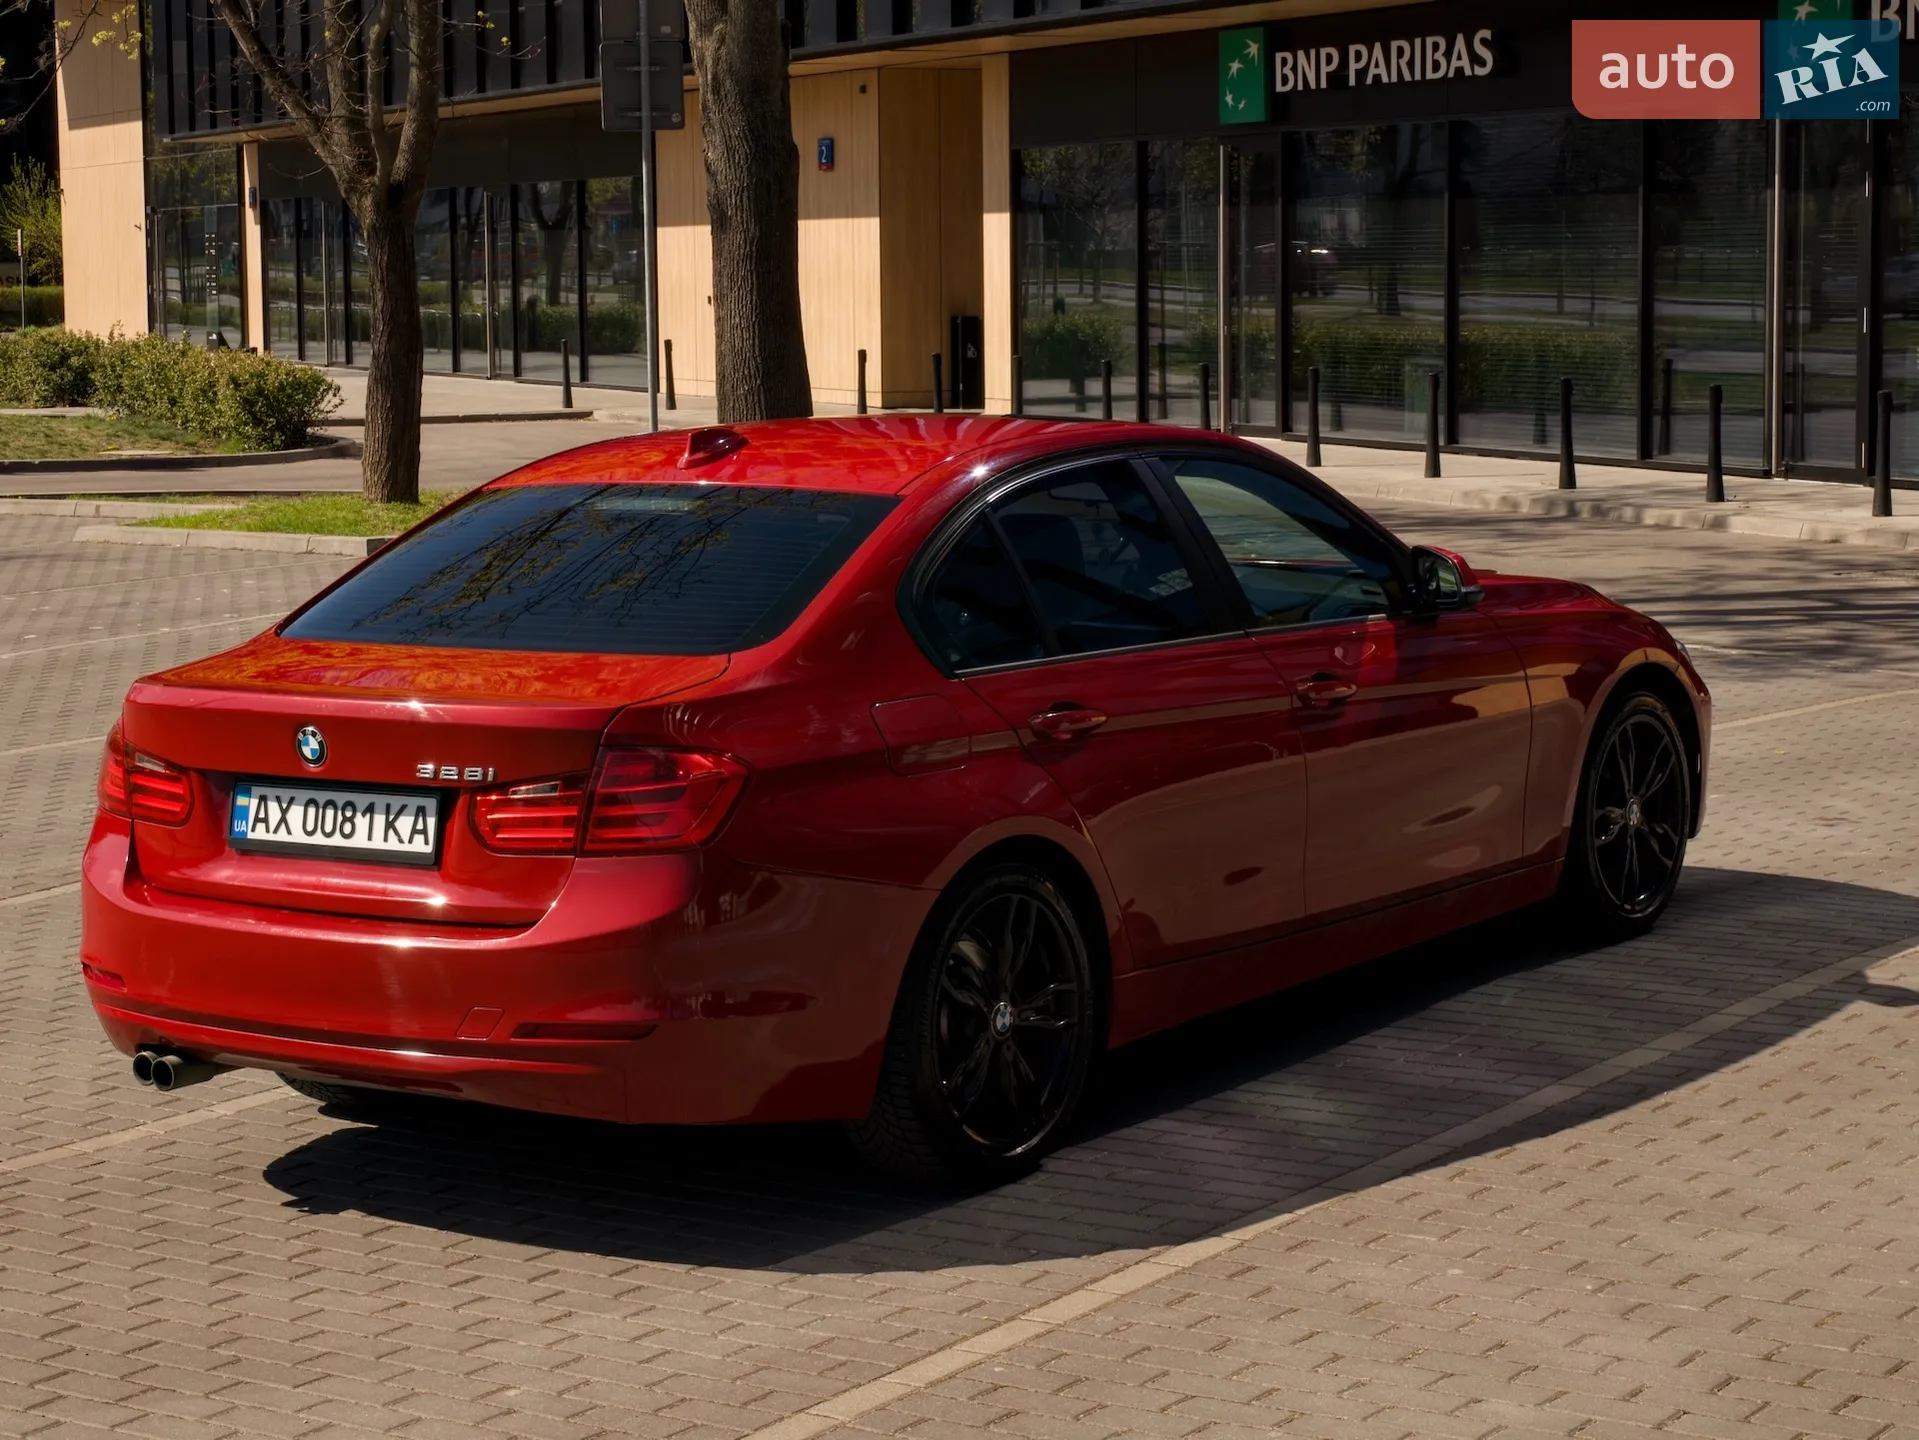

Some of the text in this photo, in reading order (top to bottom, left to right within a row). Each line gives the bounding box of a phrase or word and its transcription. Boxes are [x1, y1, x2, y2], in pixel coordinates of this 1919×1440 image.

[1275, 29, 1494, 92] BNP PARIBAS
[416, 763, 495, 781] 328i
[234, 819, 247, 832] UA
[250, 794, 431, 845] AX 0081 KA
